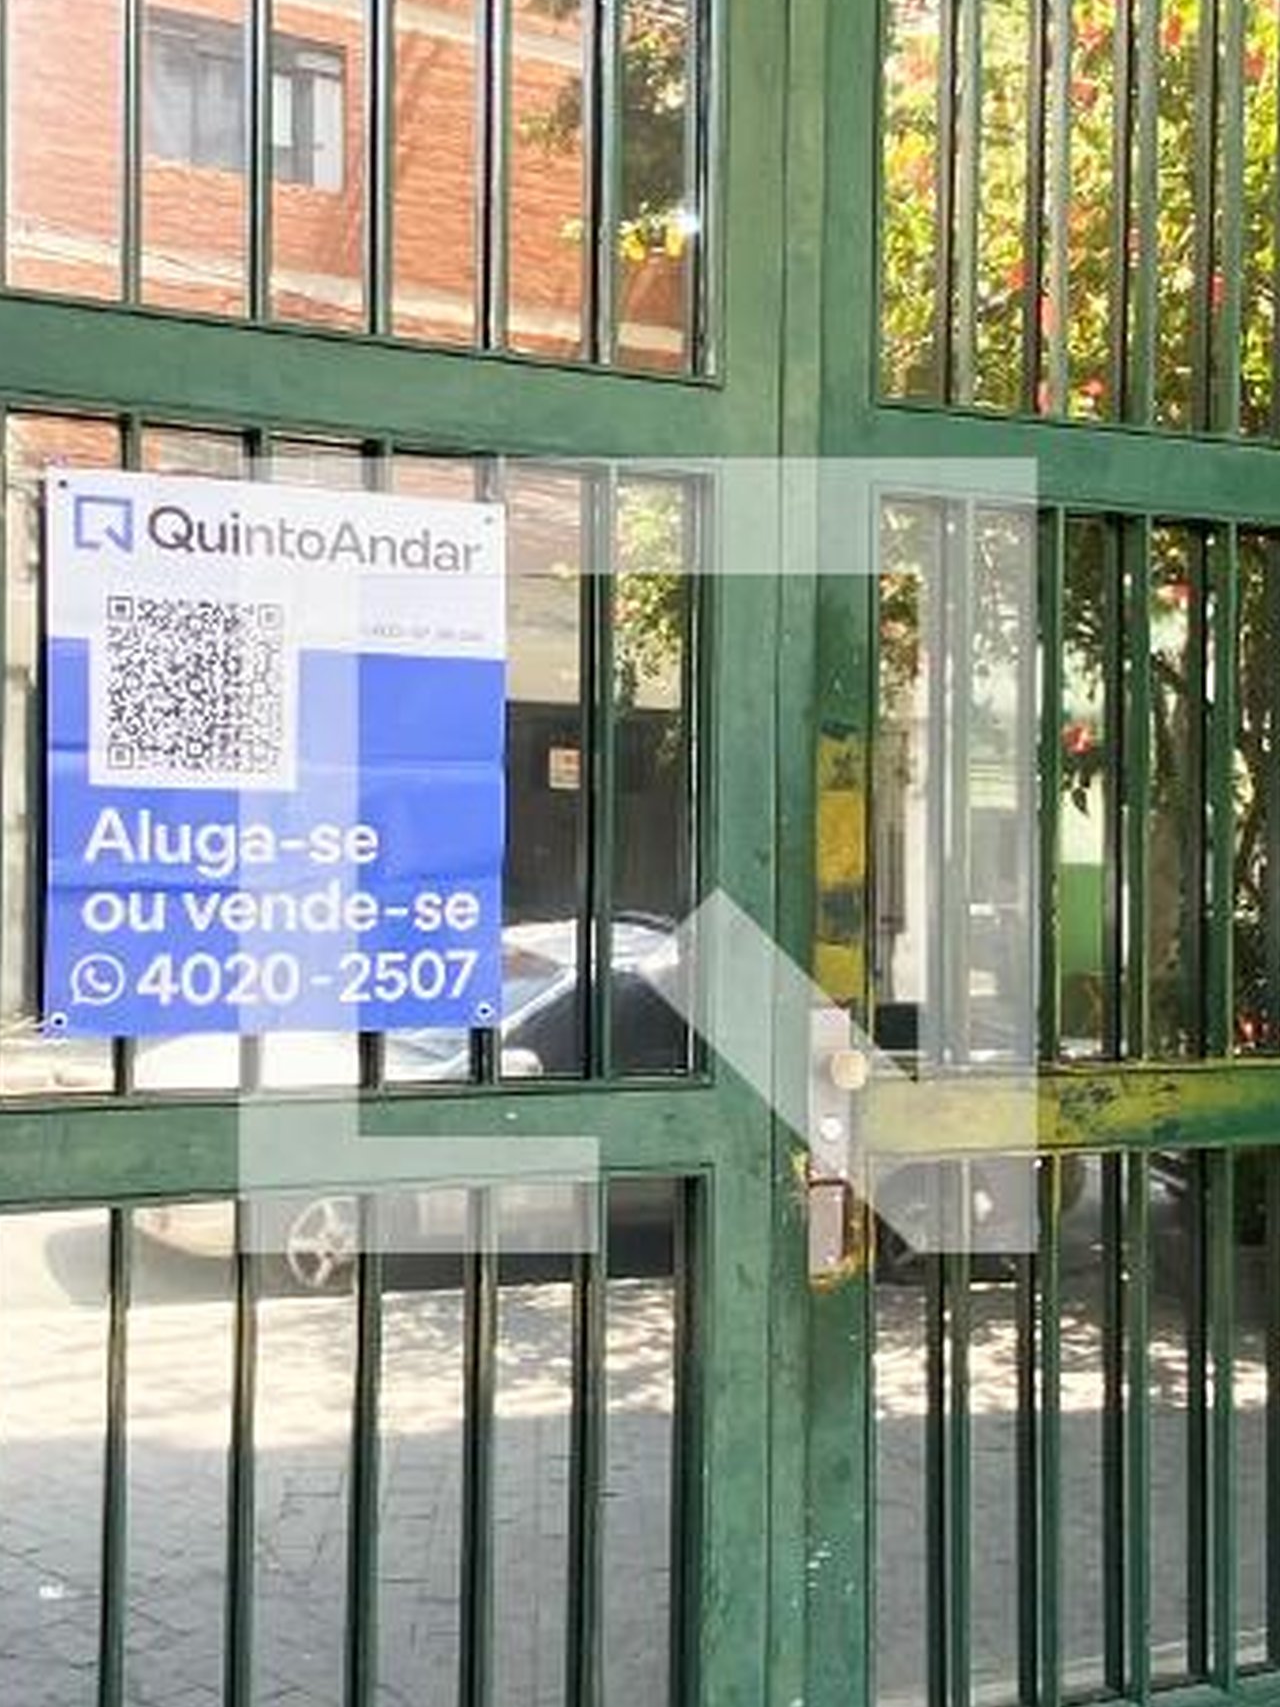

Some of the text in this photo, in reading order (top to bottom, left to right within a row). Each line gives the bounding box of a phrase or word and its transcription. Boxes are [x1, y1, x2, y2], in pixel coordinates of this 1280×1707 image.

[147, 504, 483, 573] QuintoAndar
[83, 806, 380, 879] Aluga-se
[81, 878, 481, 933] ou vende-se
[136, 948, 480, 1007] 4020-2507
